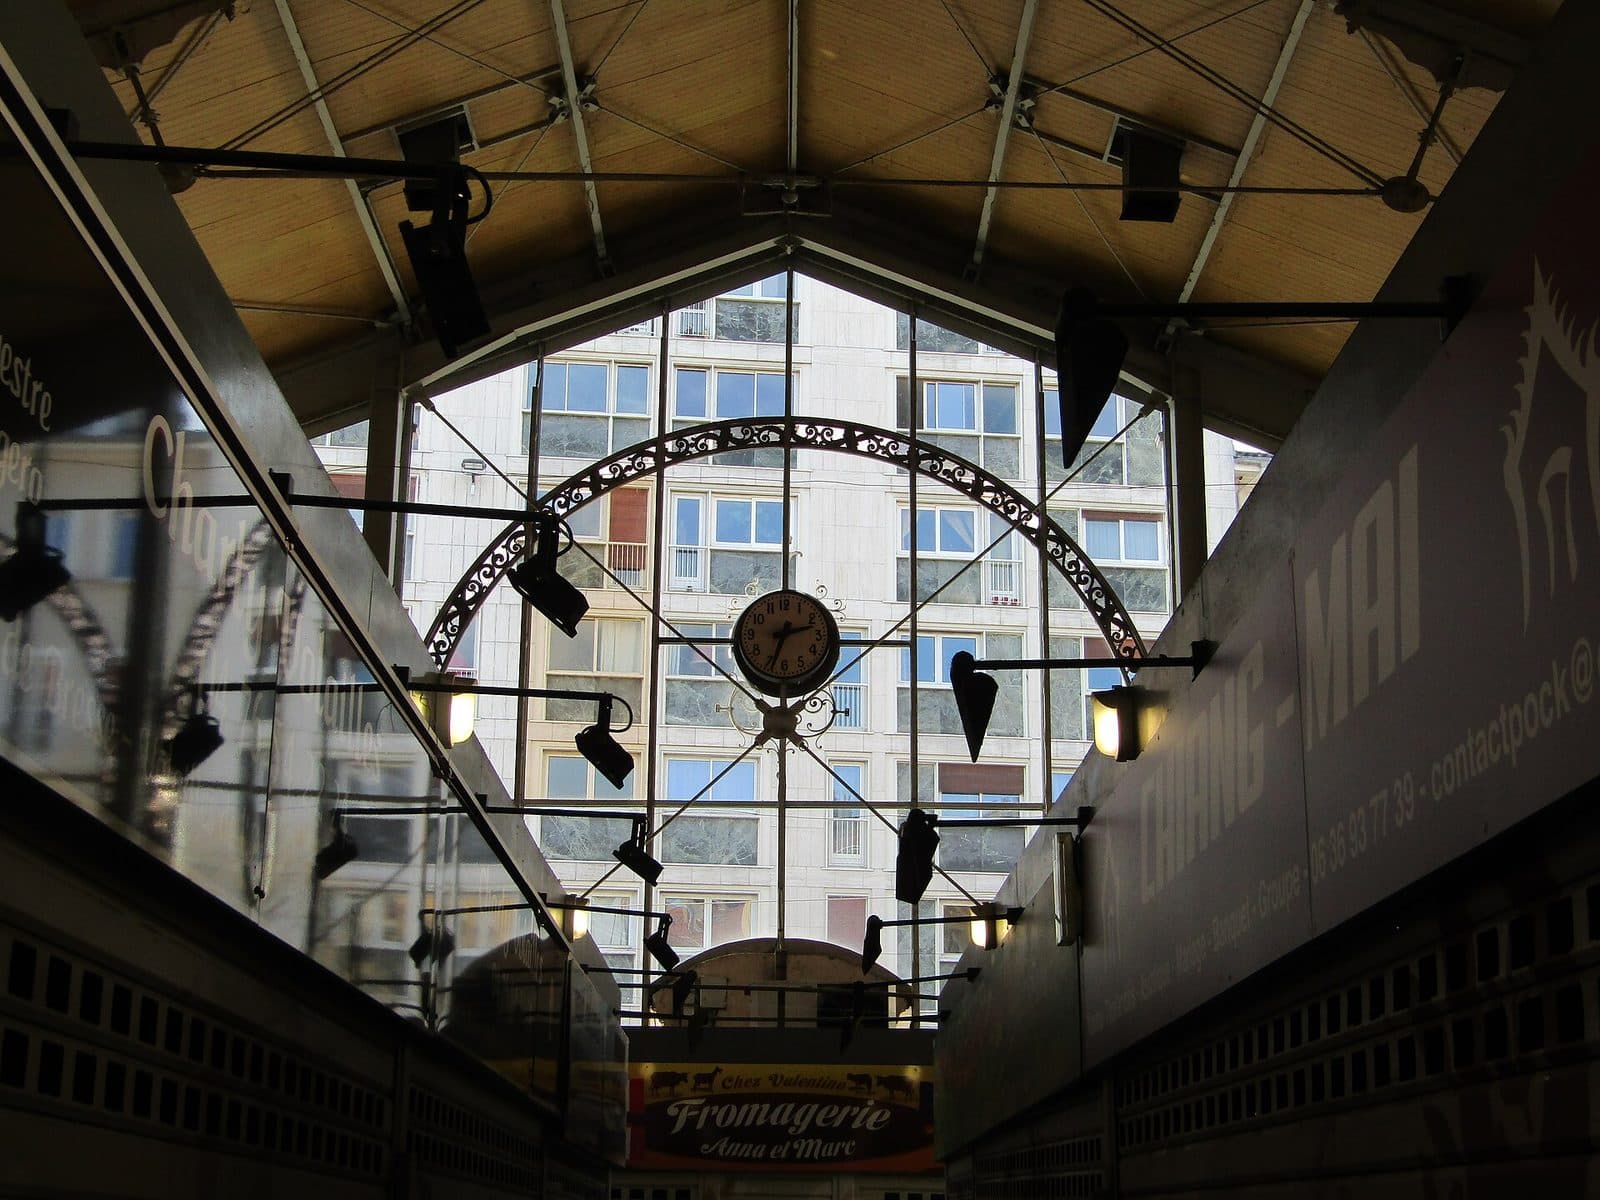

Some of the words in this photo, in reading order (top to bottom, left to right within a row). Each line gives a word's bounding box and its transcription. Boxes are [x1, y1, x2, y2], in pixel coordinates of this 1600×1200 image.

[0, 333, 52, 432] estre
[1140, 639, 1265, 906] CHIANG
[1304, 442, 1420, 752] MAI
[1258, 862, 1301, 919] Groupe
[1310, 836, 1328, 885] 06
[1329, 821, 1347, 872] 36
[1349, 807, 1367, 859] 93
[1369, 788, 1389, 845] 77
[1393, 771, 1415, 828] 39
[1431, 636, 1600, 801] contactpock@
[666, 1097, 892, 1136] Fromagerie
[721, 1074, 762, 1091] Chez
[700, 1135, 767, 1159] Anna
[791, 1137, 857, 1160] Marc
